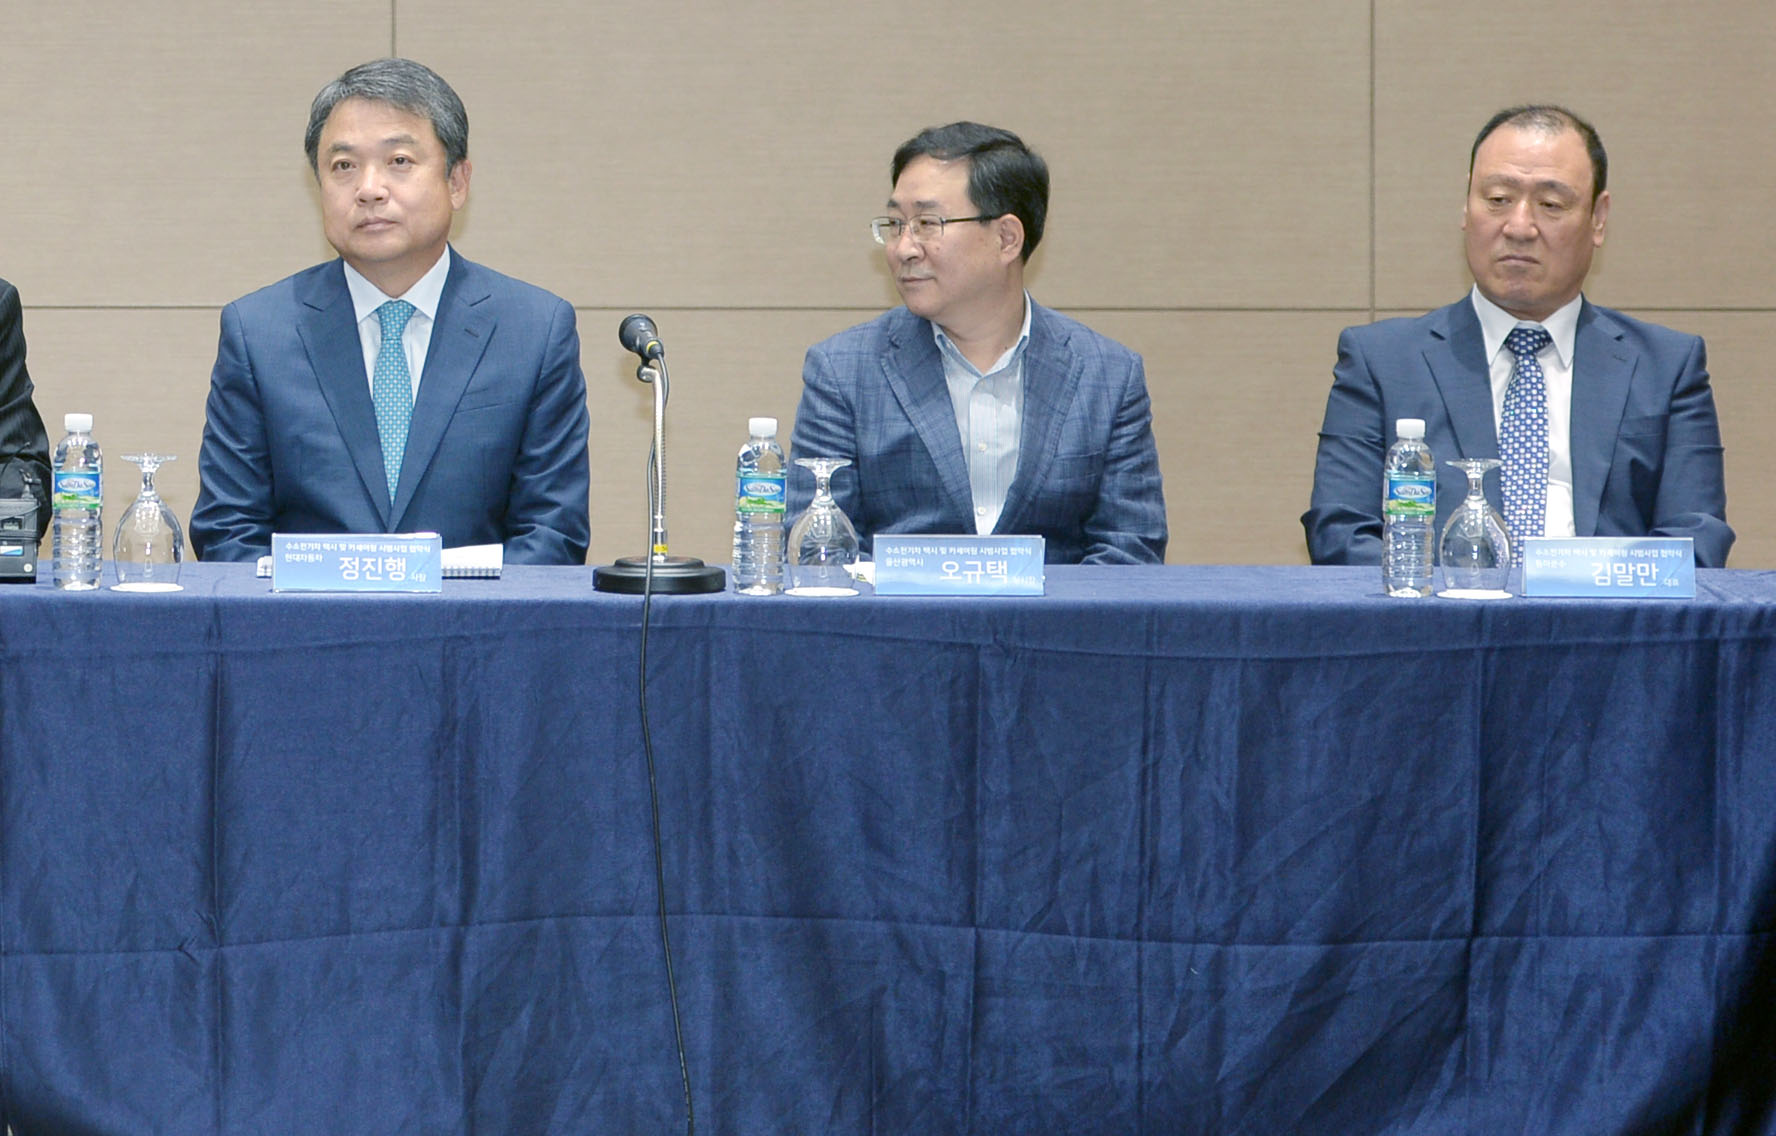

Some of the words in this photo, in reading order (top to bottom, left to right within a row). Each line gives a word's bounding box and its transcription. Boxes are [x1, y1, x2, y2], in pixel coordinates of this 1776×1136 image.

[339, 557, 406, 581] 정진행
[940, 560, 1007, 584] 오규택
[1592, 562, 1659, 586] 김말만
